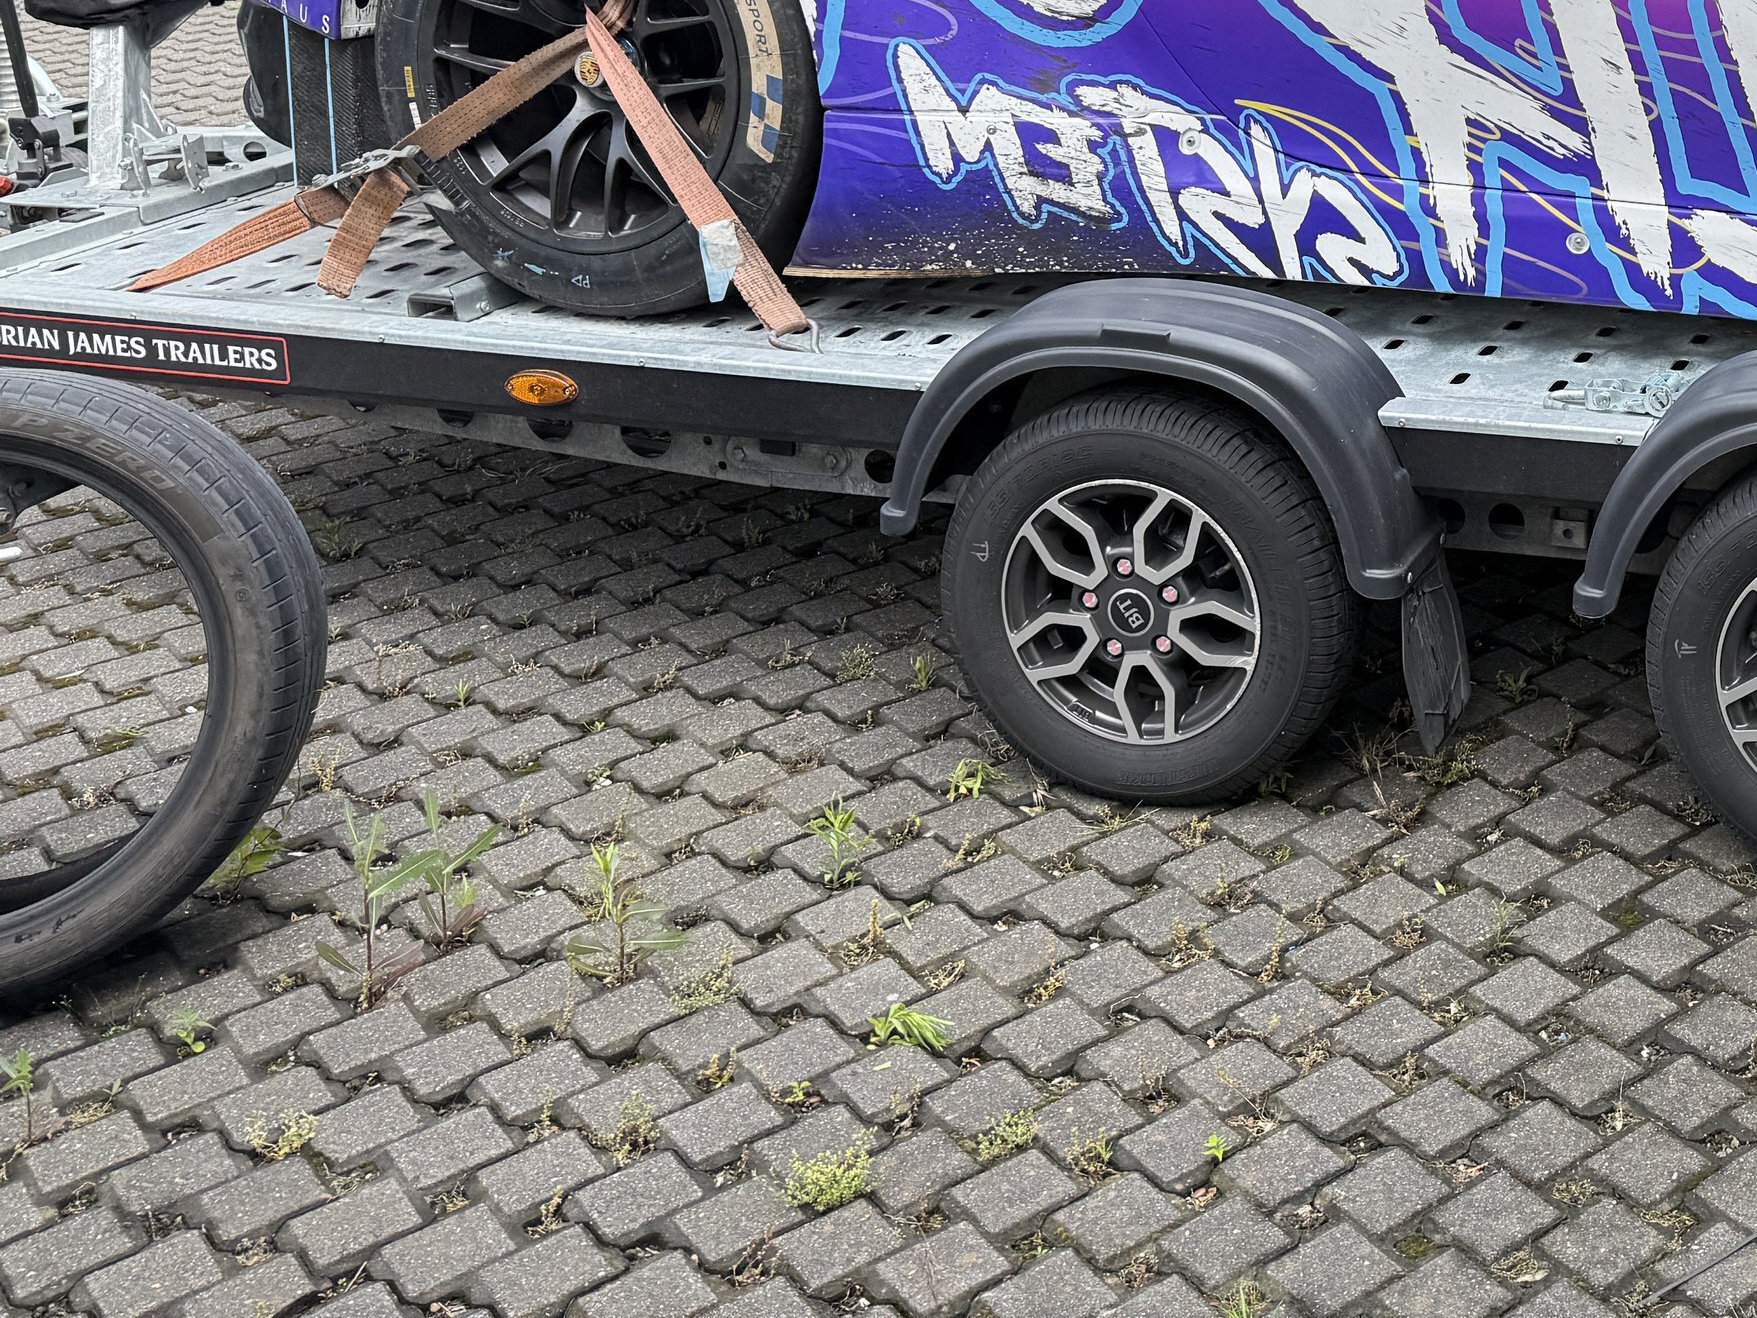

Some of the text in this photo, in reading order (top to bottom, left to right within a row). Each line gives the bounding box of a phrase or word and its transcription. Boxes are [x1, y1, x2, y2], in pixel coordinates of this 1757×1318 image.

[0, 324, 278, 371] RIAN JAMES TRAILERS
[12, 416, 176, 491] P ZERO
[1116, 598, 1145, 629] BJT
